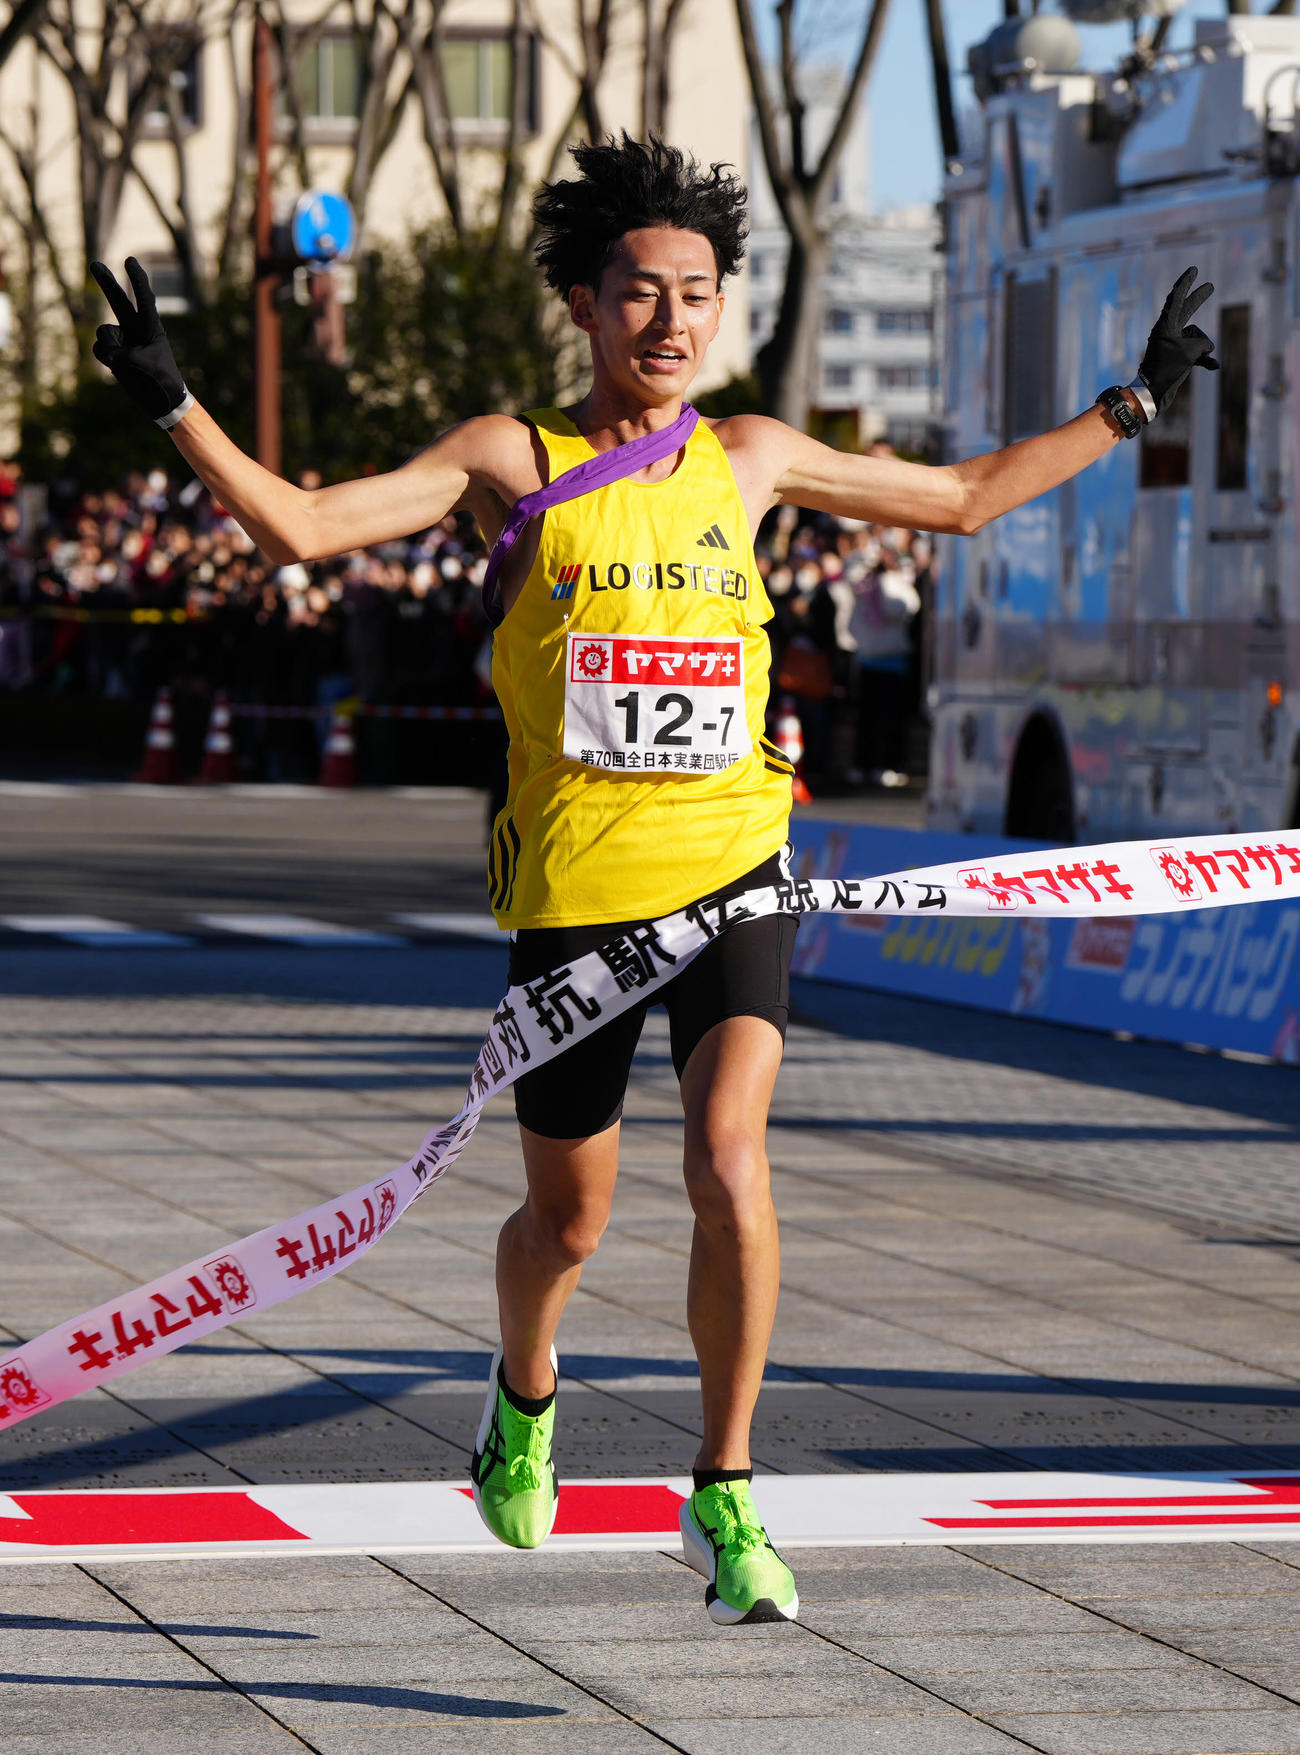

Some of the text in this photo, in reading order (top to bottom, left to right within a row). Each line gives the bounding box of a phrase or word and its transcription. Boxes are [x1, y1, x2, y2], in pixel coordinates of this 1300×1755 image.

[589, 563, 748, 601] LOGISTEED
[622, 649, 736, 677] ヤマザキ
[993, 860, 1135, 904] ヤマザキ
[1186, 843, 1300, 893] ヤマザキ
[275, 1198, 375, 1280] ヤマザキ
[67, 1275, 223, 1371] ヤマザキ
